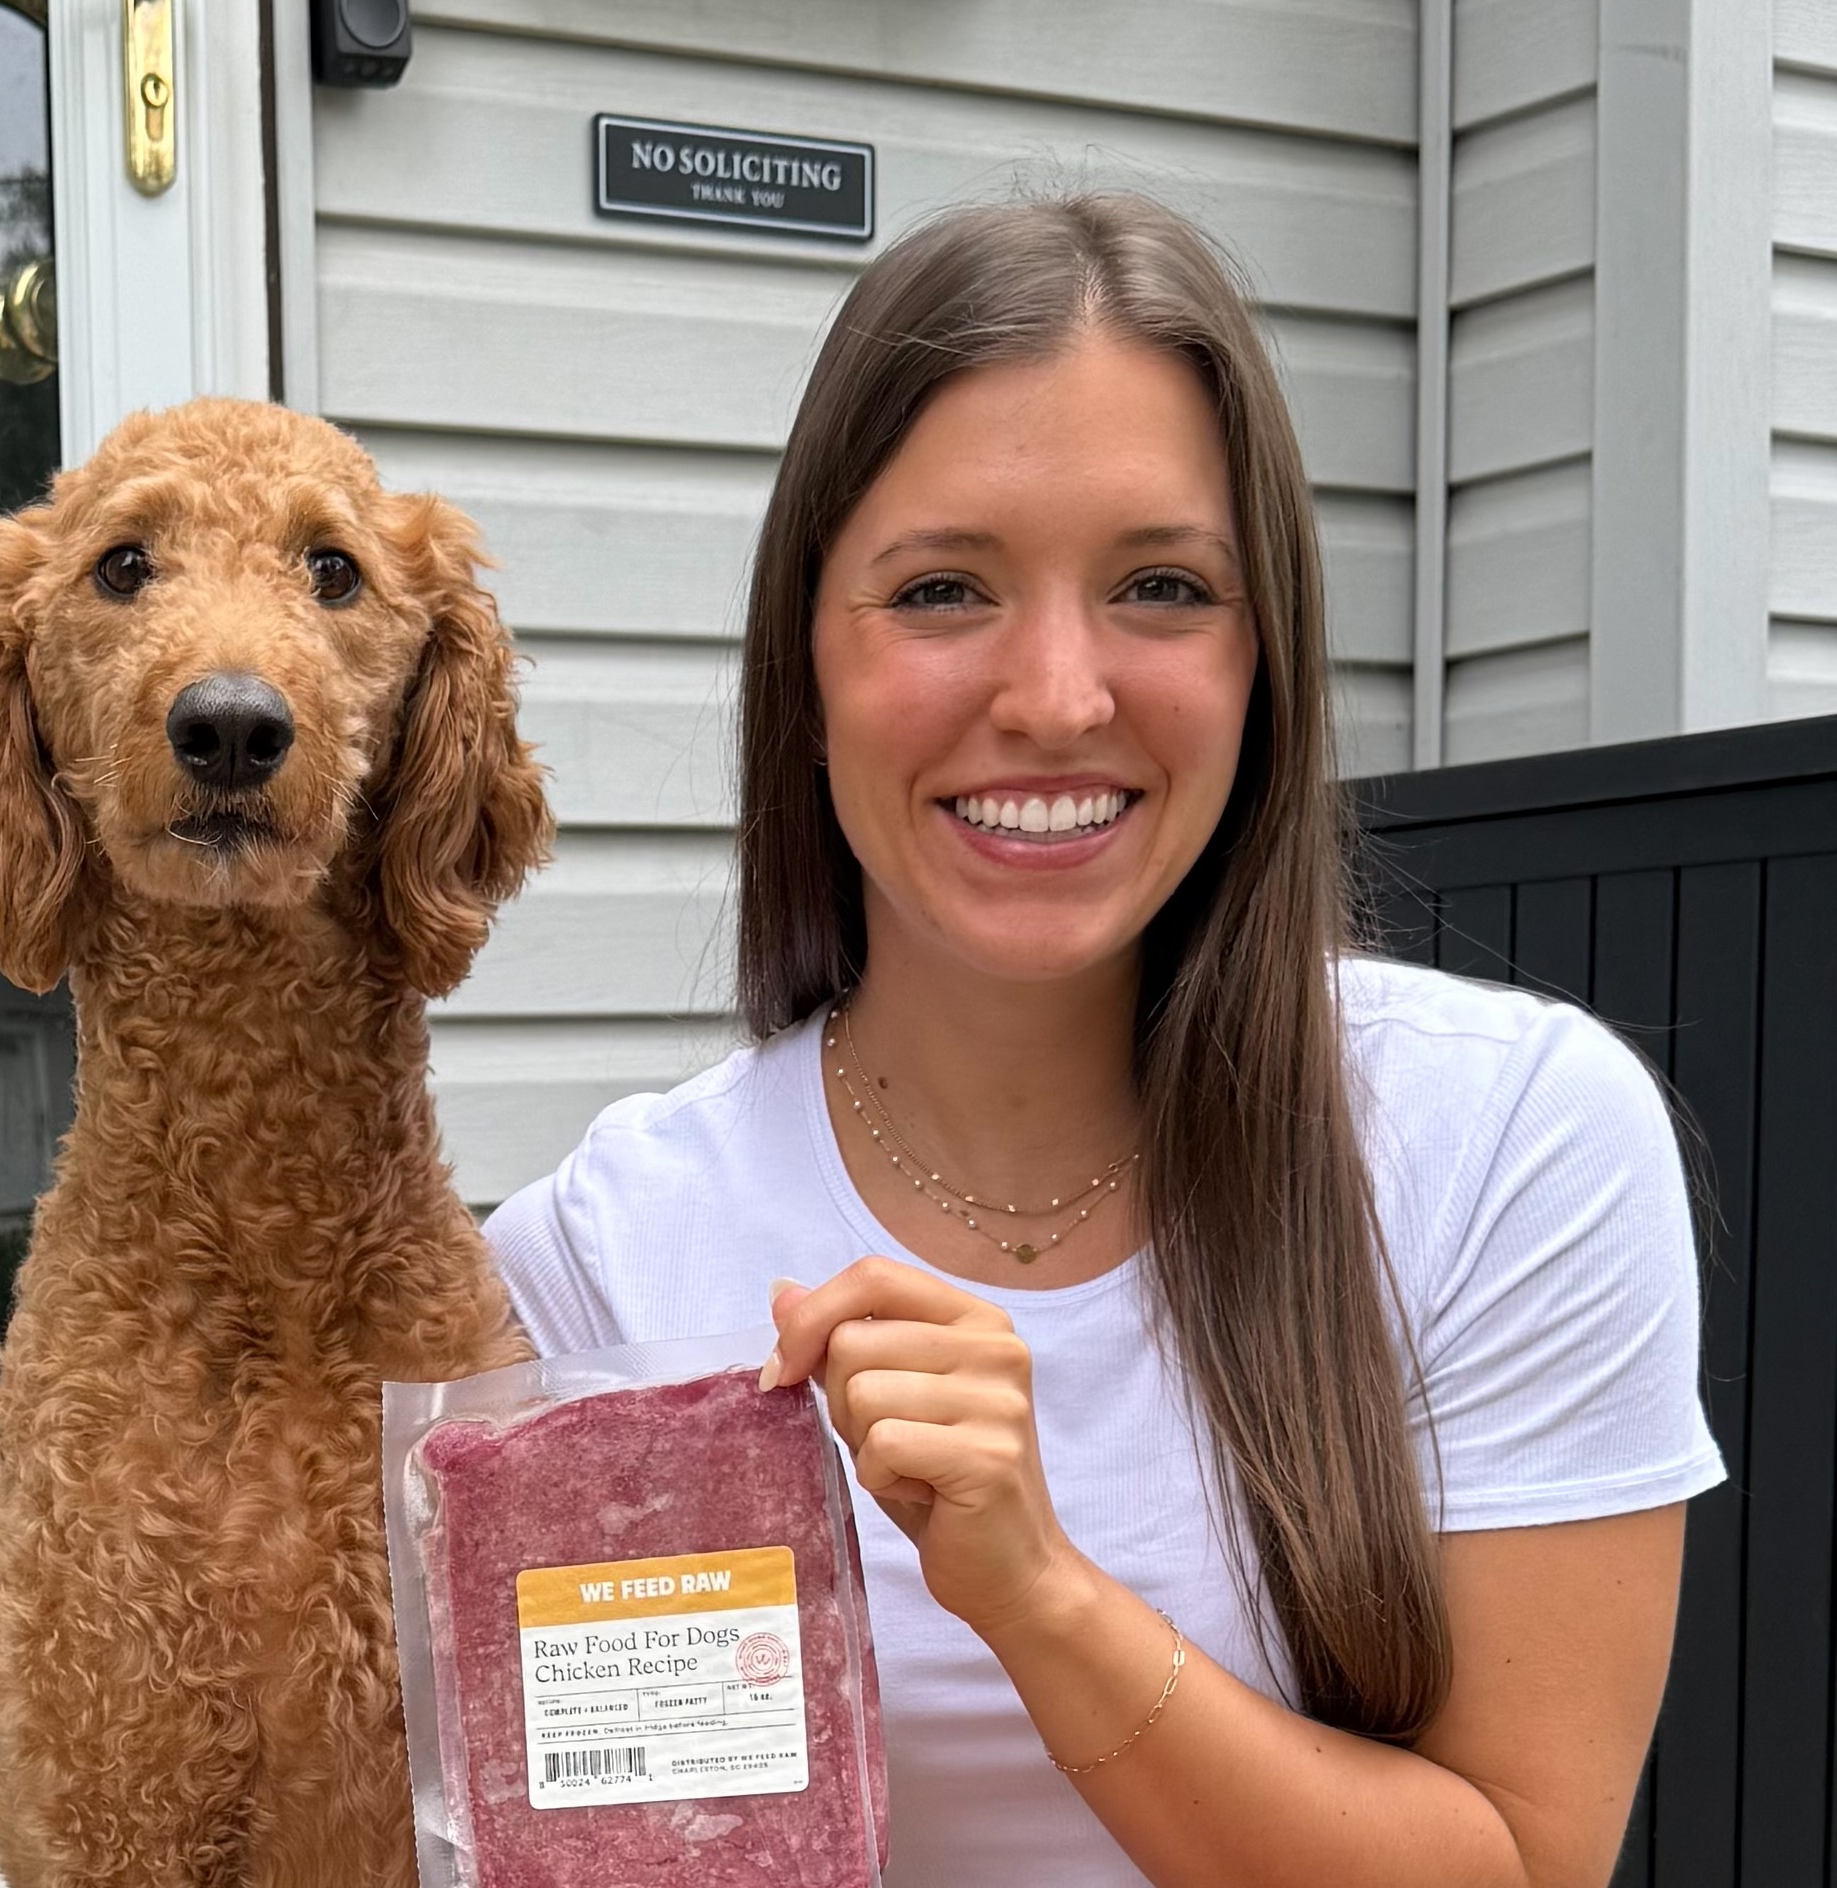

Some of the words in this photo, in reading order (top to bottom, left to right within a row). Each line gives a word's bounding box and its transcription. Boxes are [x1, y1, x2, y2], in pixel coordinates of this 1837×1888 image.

[631, 140, 675, 172] NO
[678, 146, 842, 191] SOLICITING
[691, 183, 746, 204] THANK
[751, 191, 785, 209] YOU
[579, 1581, 615, 1603] WE
[621, 1577, 676, 1600] FEED
[680, 1570, 732, 1596] RAW
[534, 1640, 579, 1658] Raw
[584, 1632, 638, 1655] Food
[644, 1631, 681, 1650] For
[686, 1626, 740, 1648] Dogs
[535, 1661, 621, 1683] Chicken
[628, 1655, 699, 1676] Recipe
[671, 1756, 726, 1767] DISTRIBUTED
